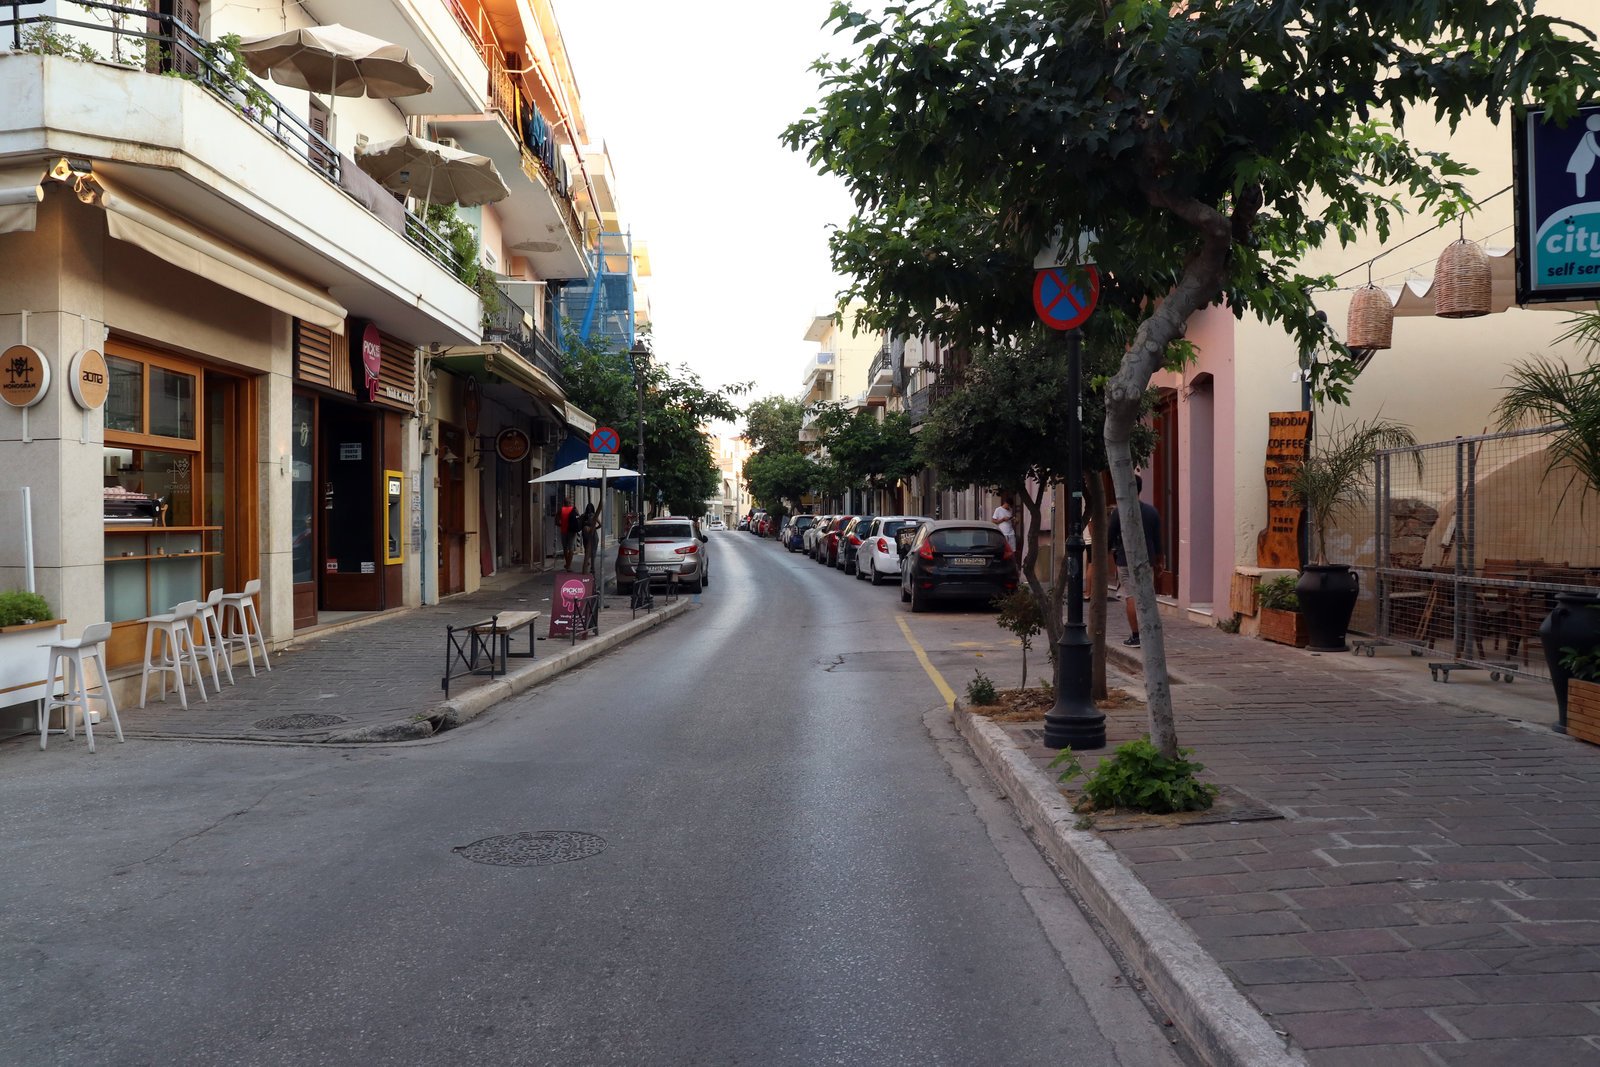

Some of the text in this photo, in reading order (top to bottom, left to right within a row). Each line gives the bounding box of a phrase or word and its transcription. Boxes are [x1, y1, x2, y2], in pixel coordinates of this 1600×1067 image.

[1547, 262, 1576, 277] self
[1270, 417, 1308, 427] ENODIA
[1268, 439, 1305, 448] COFFEE
